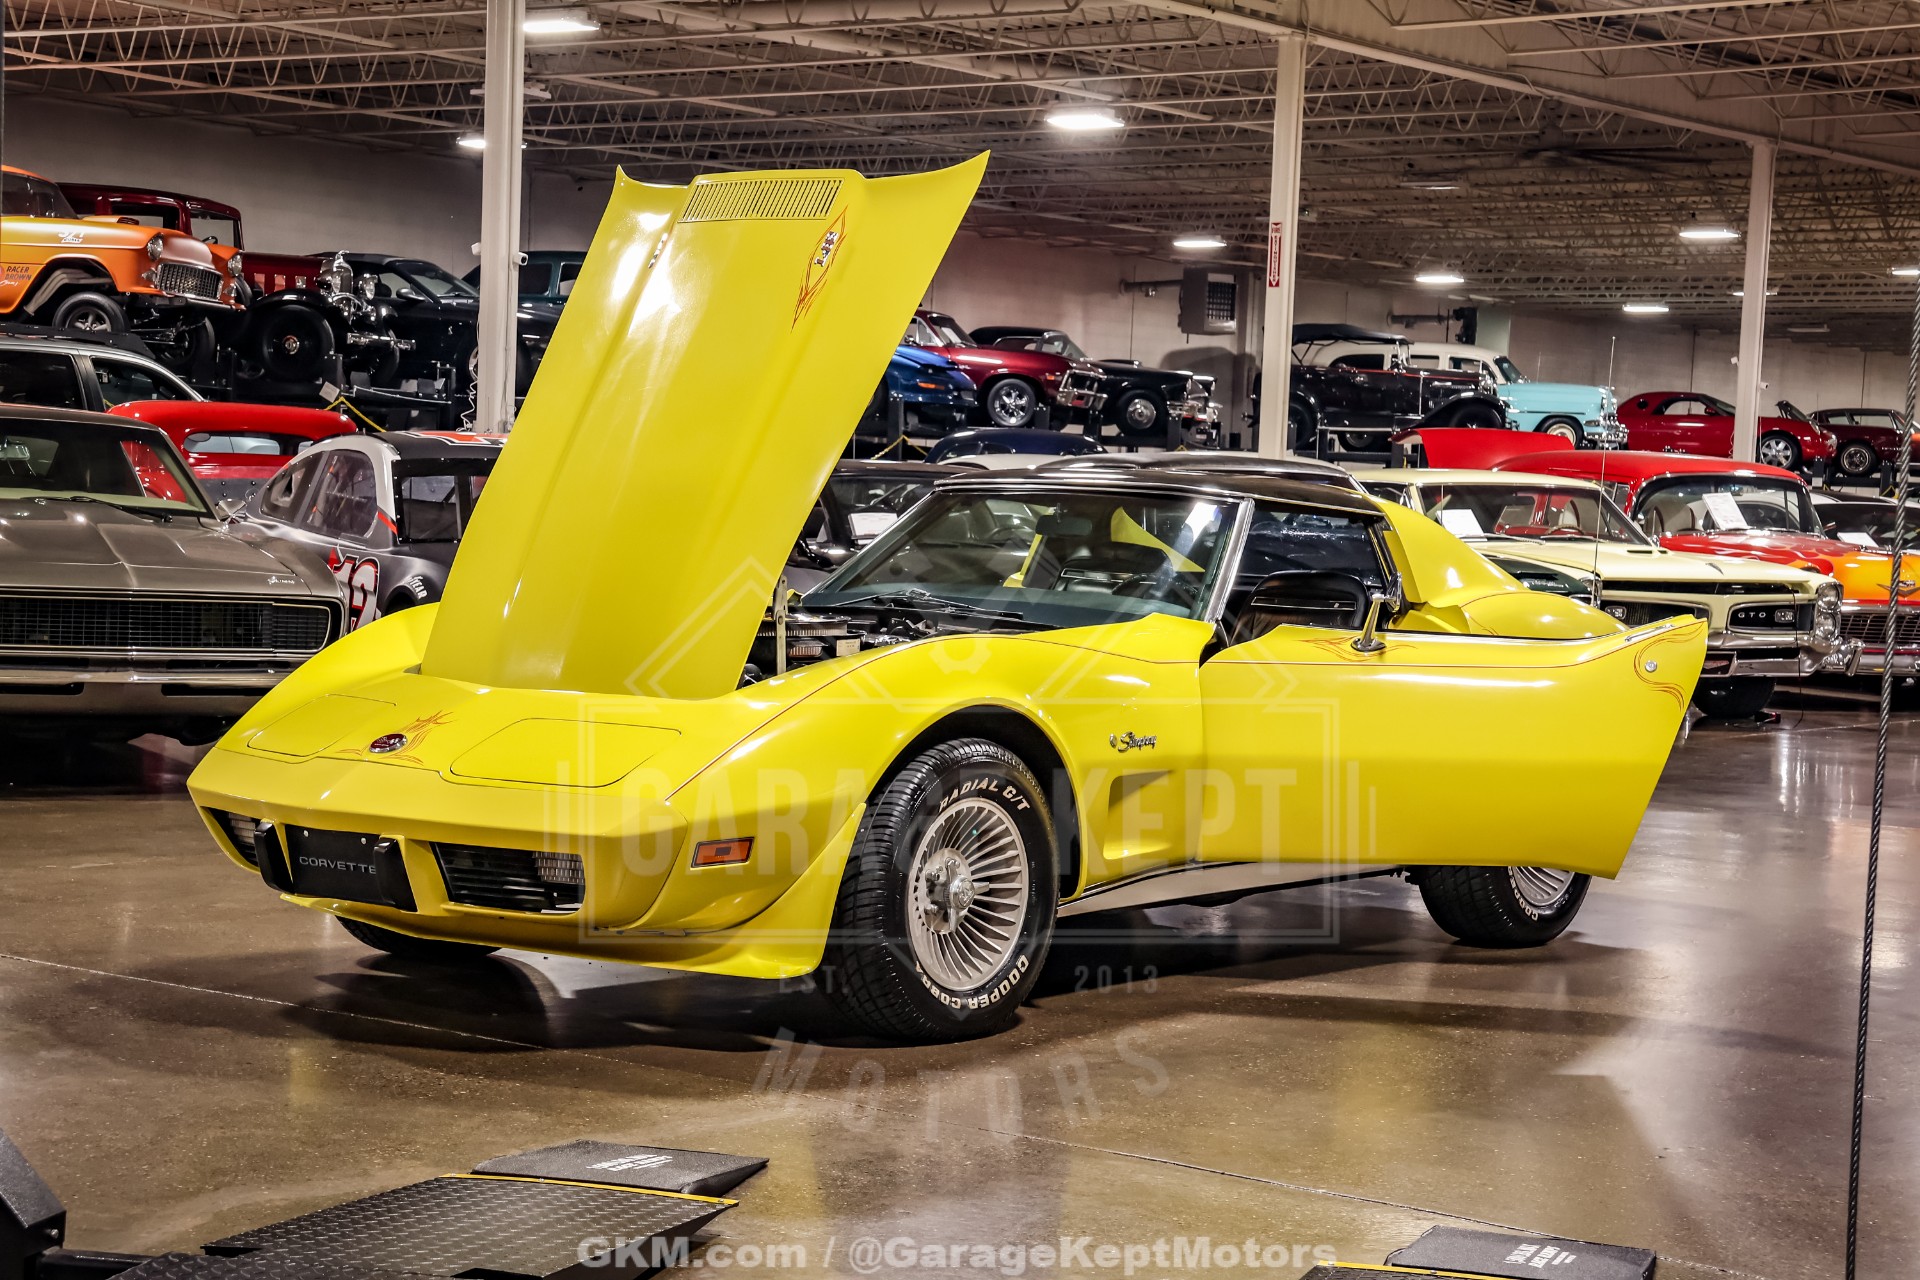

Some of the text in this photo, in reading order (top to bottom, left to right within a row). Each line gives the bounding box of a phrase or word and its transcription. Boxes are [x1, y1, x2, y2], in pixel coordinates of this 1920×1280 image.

[6, 265, 30, 273] RACER
[1737, 611, 1767, 619] GTO
[938, 777, 1031, 814] RADIAL G/T
[299, 856, 377, 875] CORVETTE
[915, 954, 1030, 1010] COOPER COBRA
